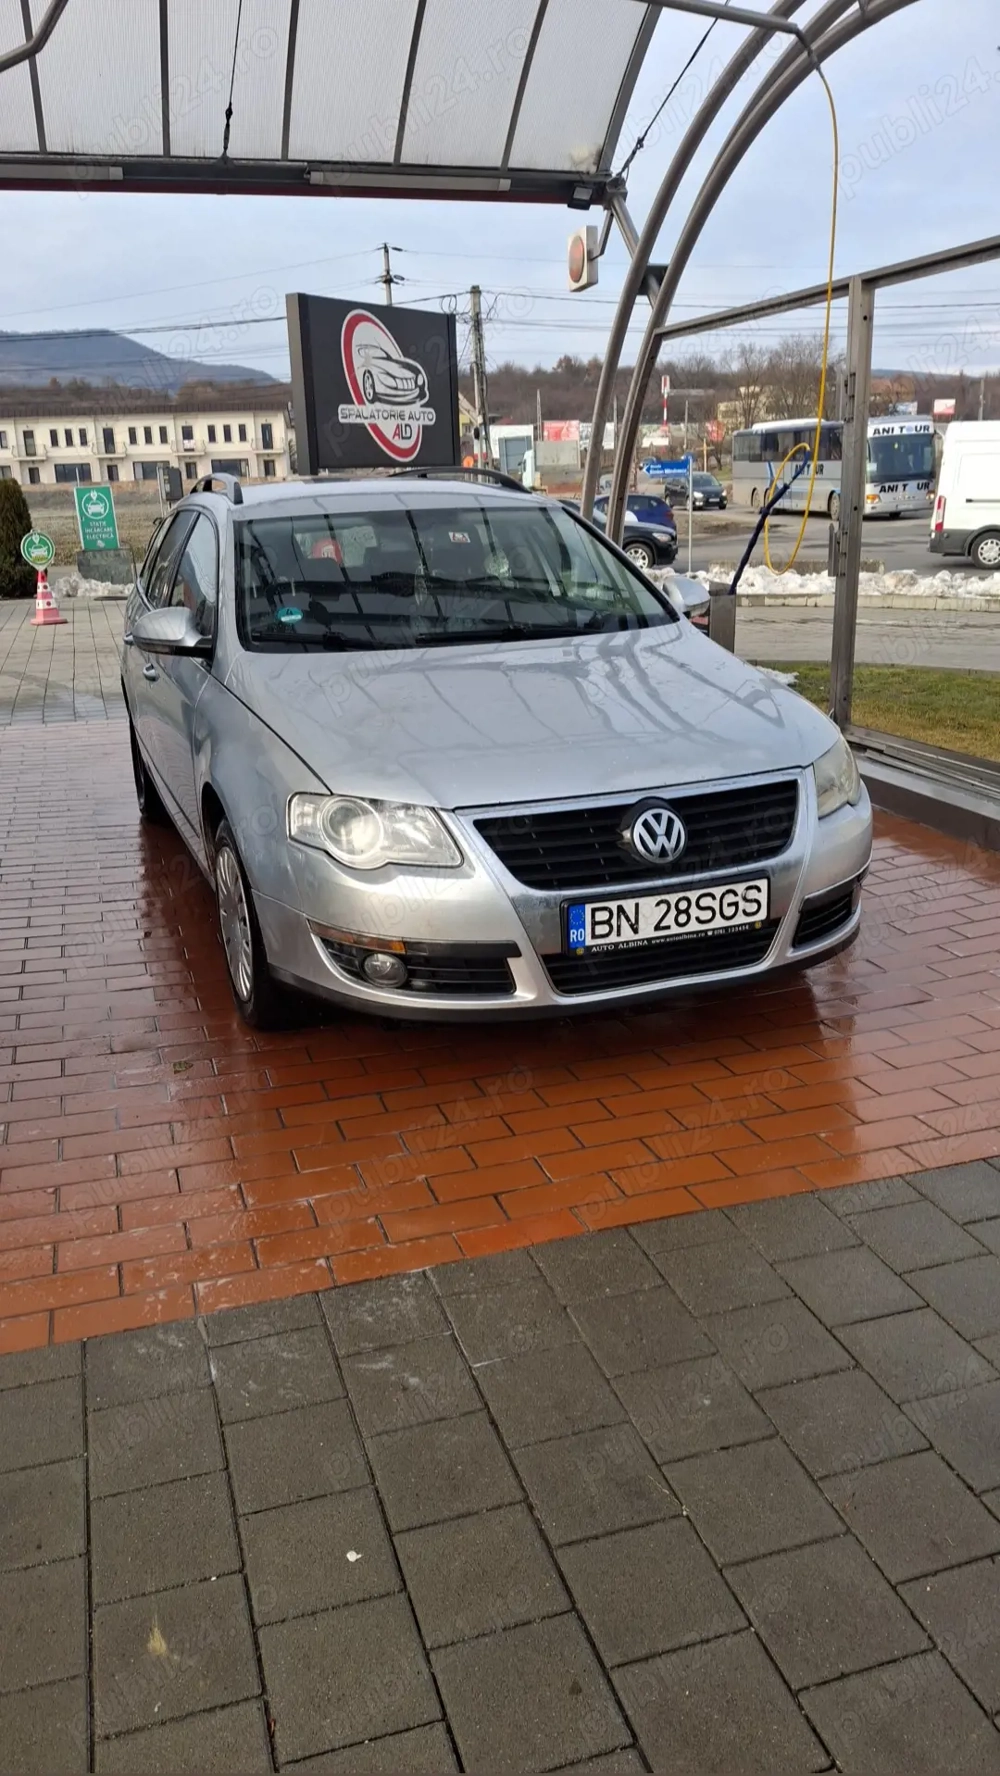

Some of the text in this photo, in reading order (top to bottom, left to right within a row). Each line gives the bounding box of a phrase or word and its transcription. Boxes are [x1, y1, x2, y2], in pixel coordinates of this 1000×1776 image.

[340, 407, 435, 422] SPALATORIE AUTO
[392, 423, 412, 440] ALD
[872, 426, 895, 436] ANI
[879, 483, 899, 494] ANI
[591, 885, 762, 940] BN 28SGS
[569, 928, 585, 943] RO
[591, 944, 615, 953] AUTO
[618, 940, 648, 949] ALBINA
